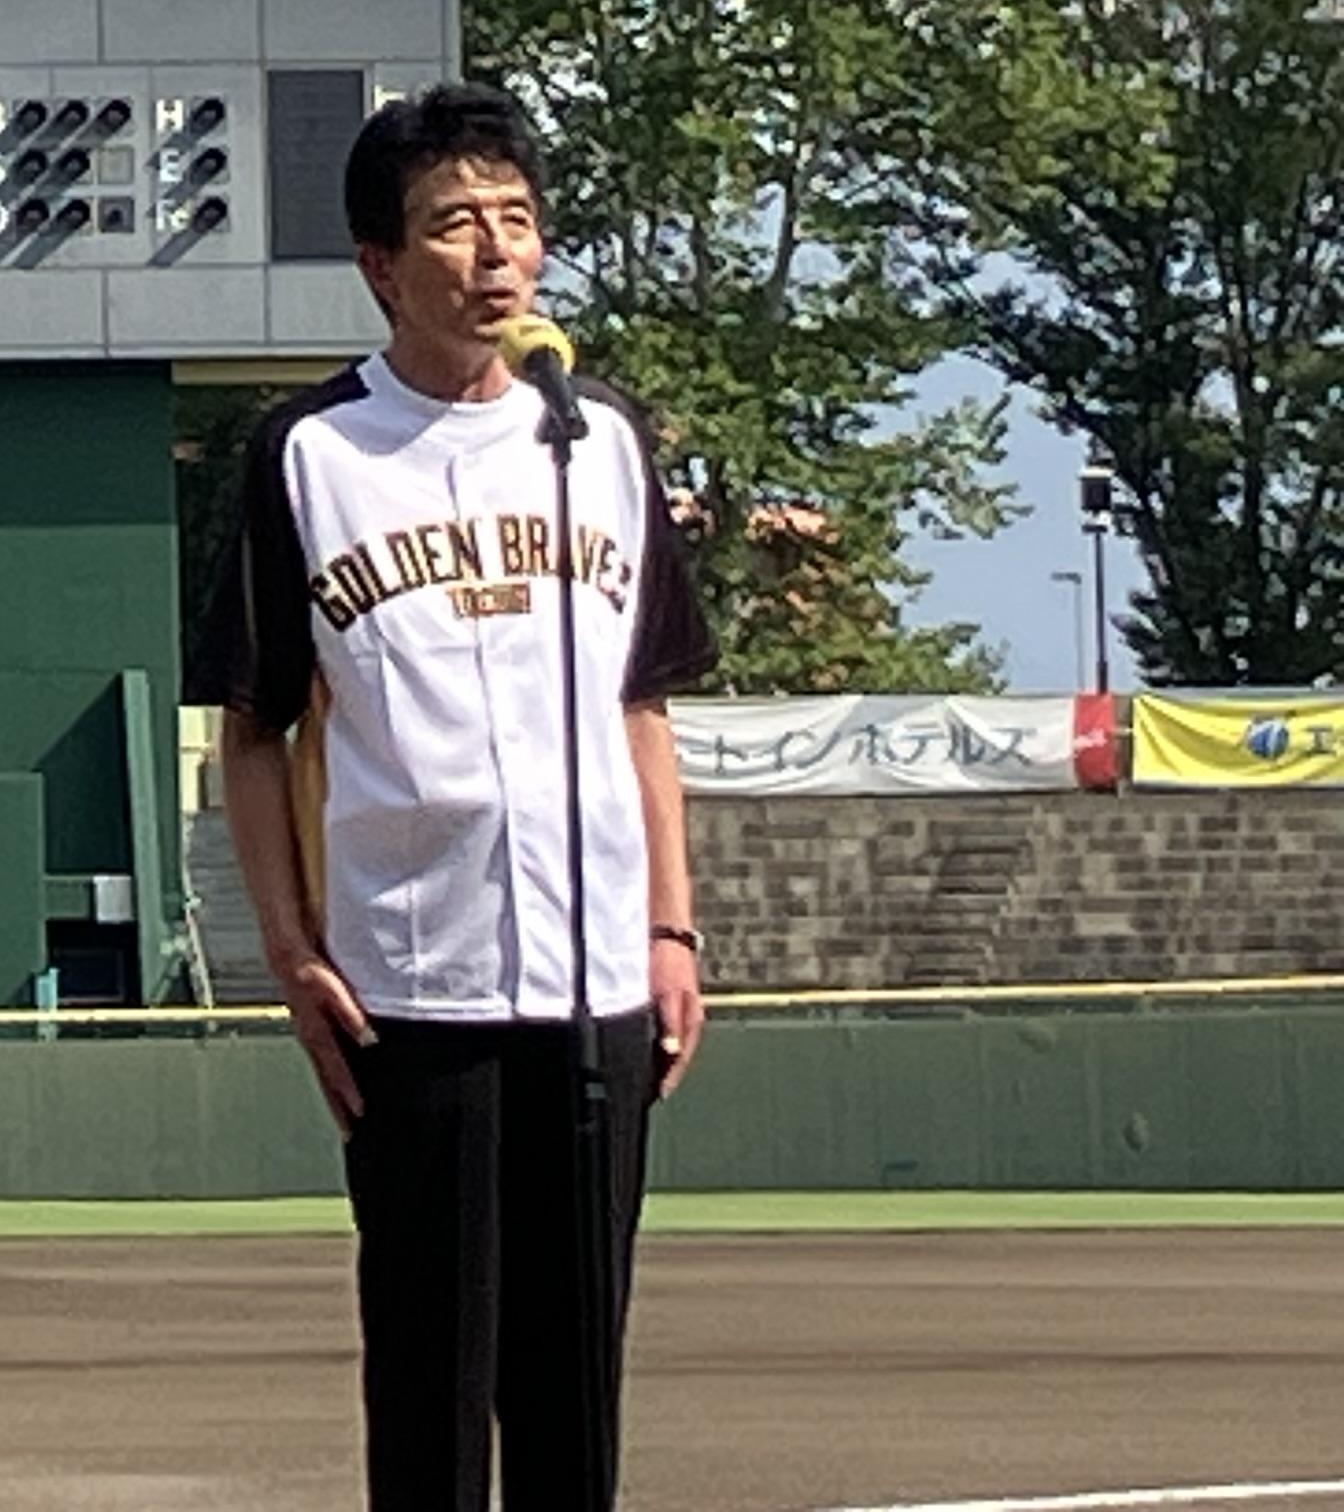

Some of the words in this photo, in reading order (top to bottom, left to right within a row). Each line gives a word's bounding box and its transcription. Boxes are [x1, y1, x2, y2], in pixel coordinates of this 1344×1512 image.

[155, 98, 184, 132] H
[159, 149, 183, 182] E
[311, 518, 484, 633] GOLDEN
